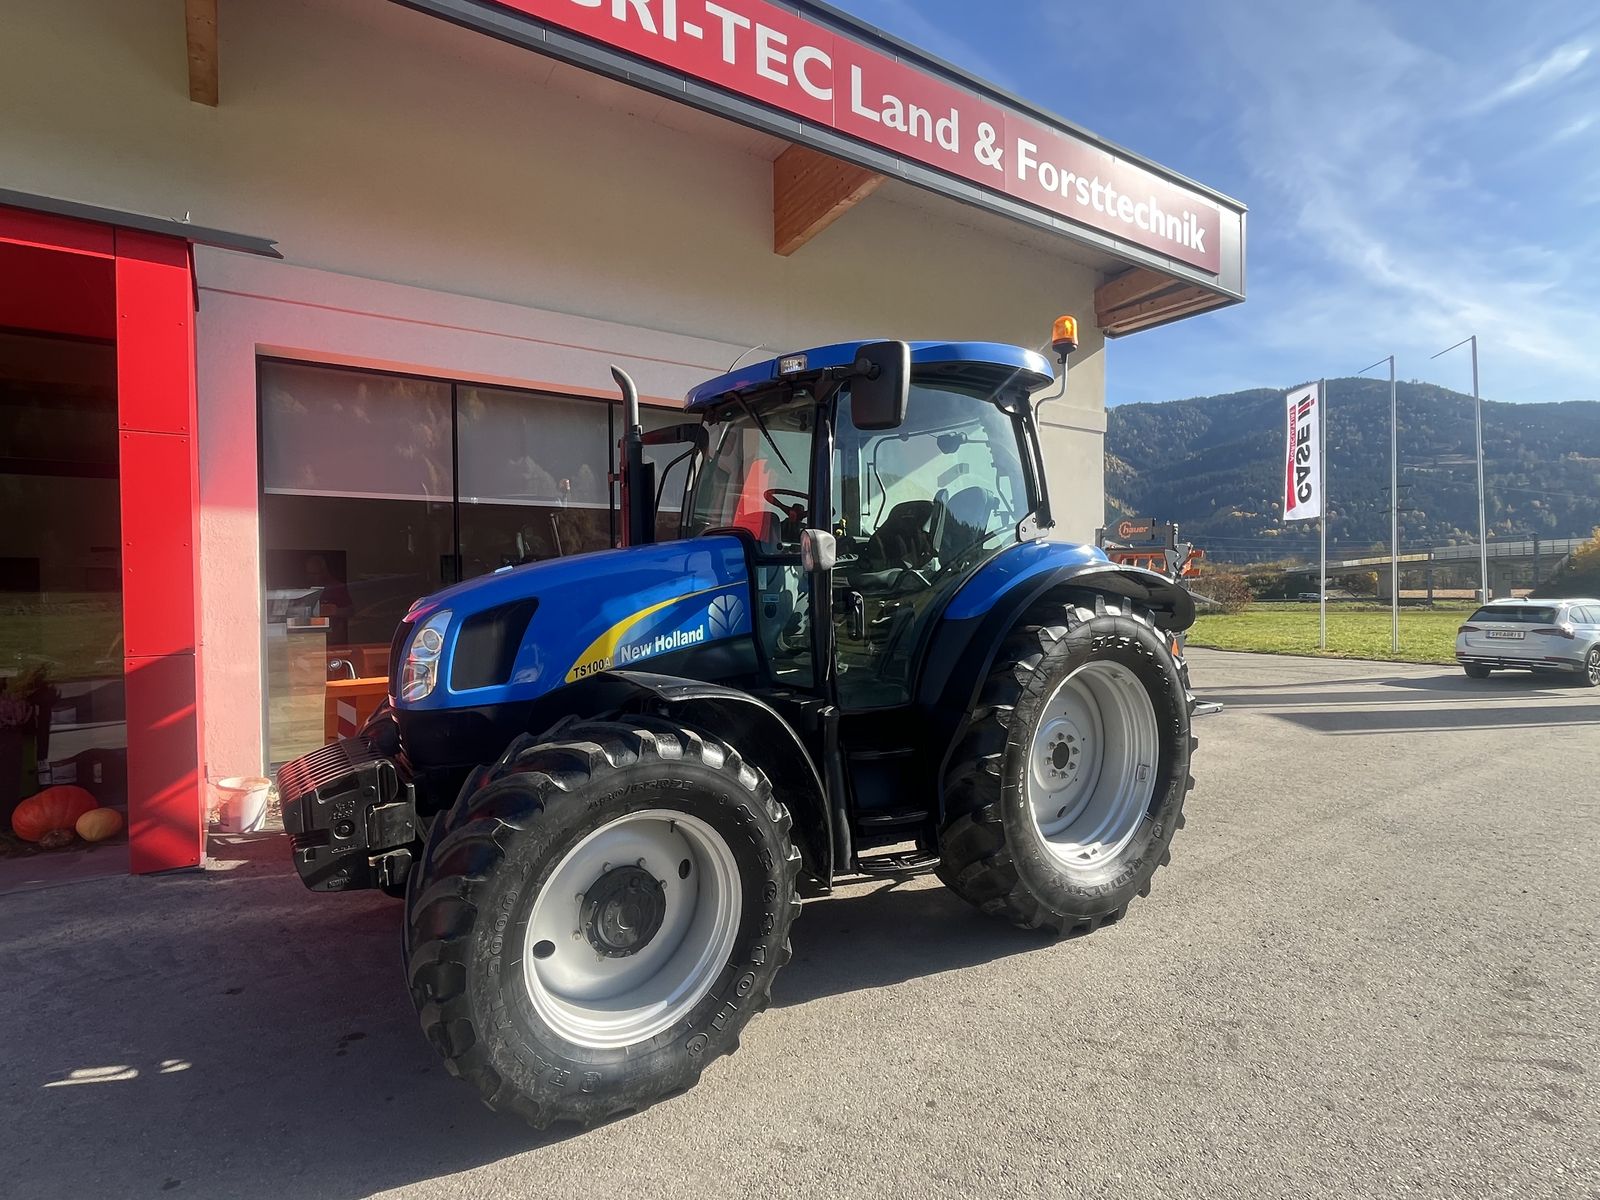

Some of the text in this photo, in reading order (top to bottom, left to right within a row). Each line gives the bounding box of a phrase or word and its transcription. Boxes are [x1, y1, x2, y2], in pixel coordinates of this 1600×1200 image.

[850, 63, 960, 154] Land
[973, 121, 1004, 172] &
[1016, 137, 1206, 254] Forsttechnik
[620, 624, 704, 663] New Holland
[573, 656, 612, 679] TS100A
